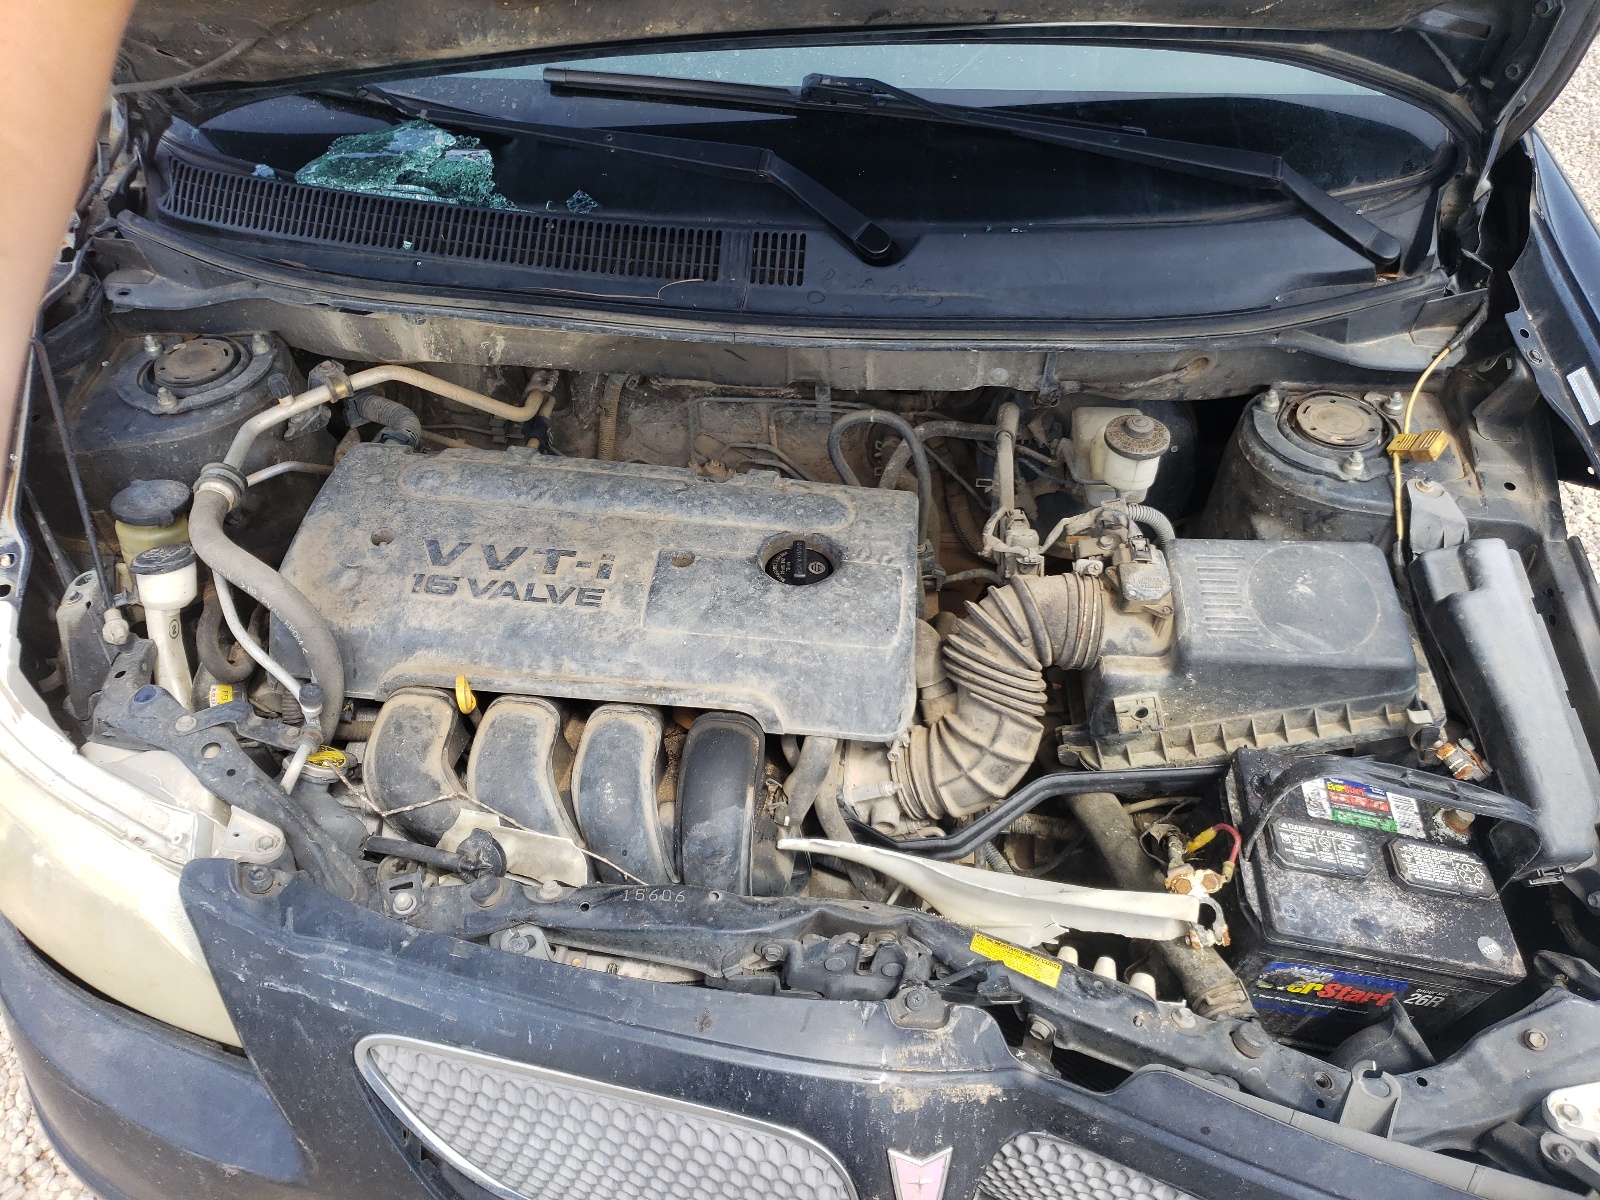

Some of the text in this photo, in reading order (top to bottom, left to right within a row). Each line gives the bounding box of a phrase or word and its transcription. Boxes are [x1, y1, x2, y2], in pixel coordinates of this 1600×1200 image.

[411, 573, 606, 608] 16 VALVE
[1326, 781, 1366, 797] EverStart
[1288, 823, 1320, 835] DANGER
[1326, 829, 1355, 841] POISON
[622, 888, 686, 903] 15606
[1402, 992, 1446, 1008] 26R
